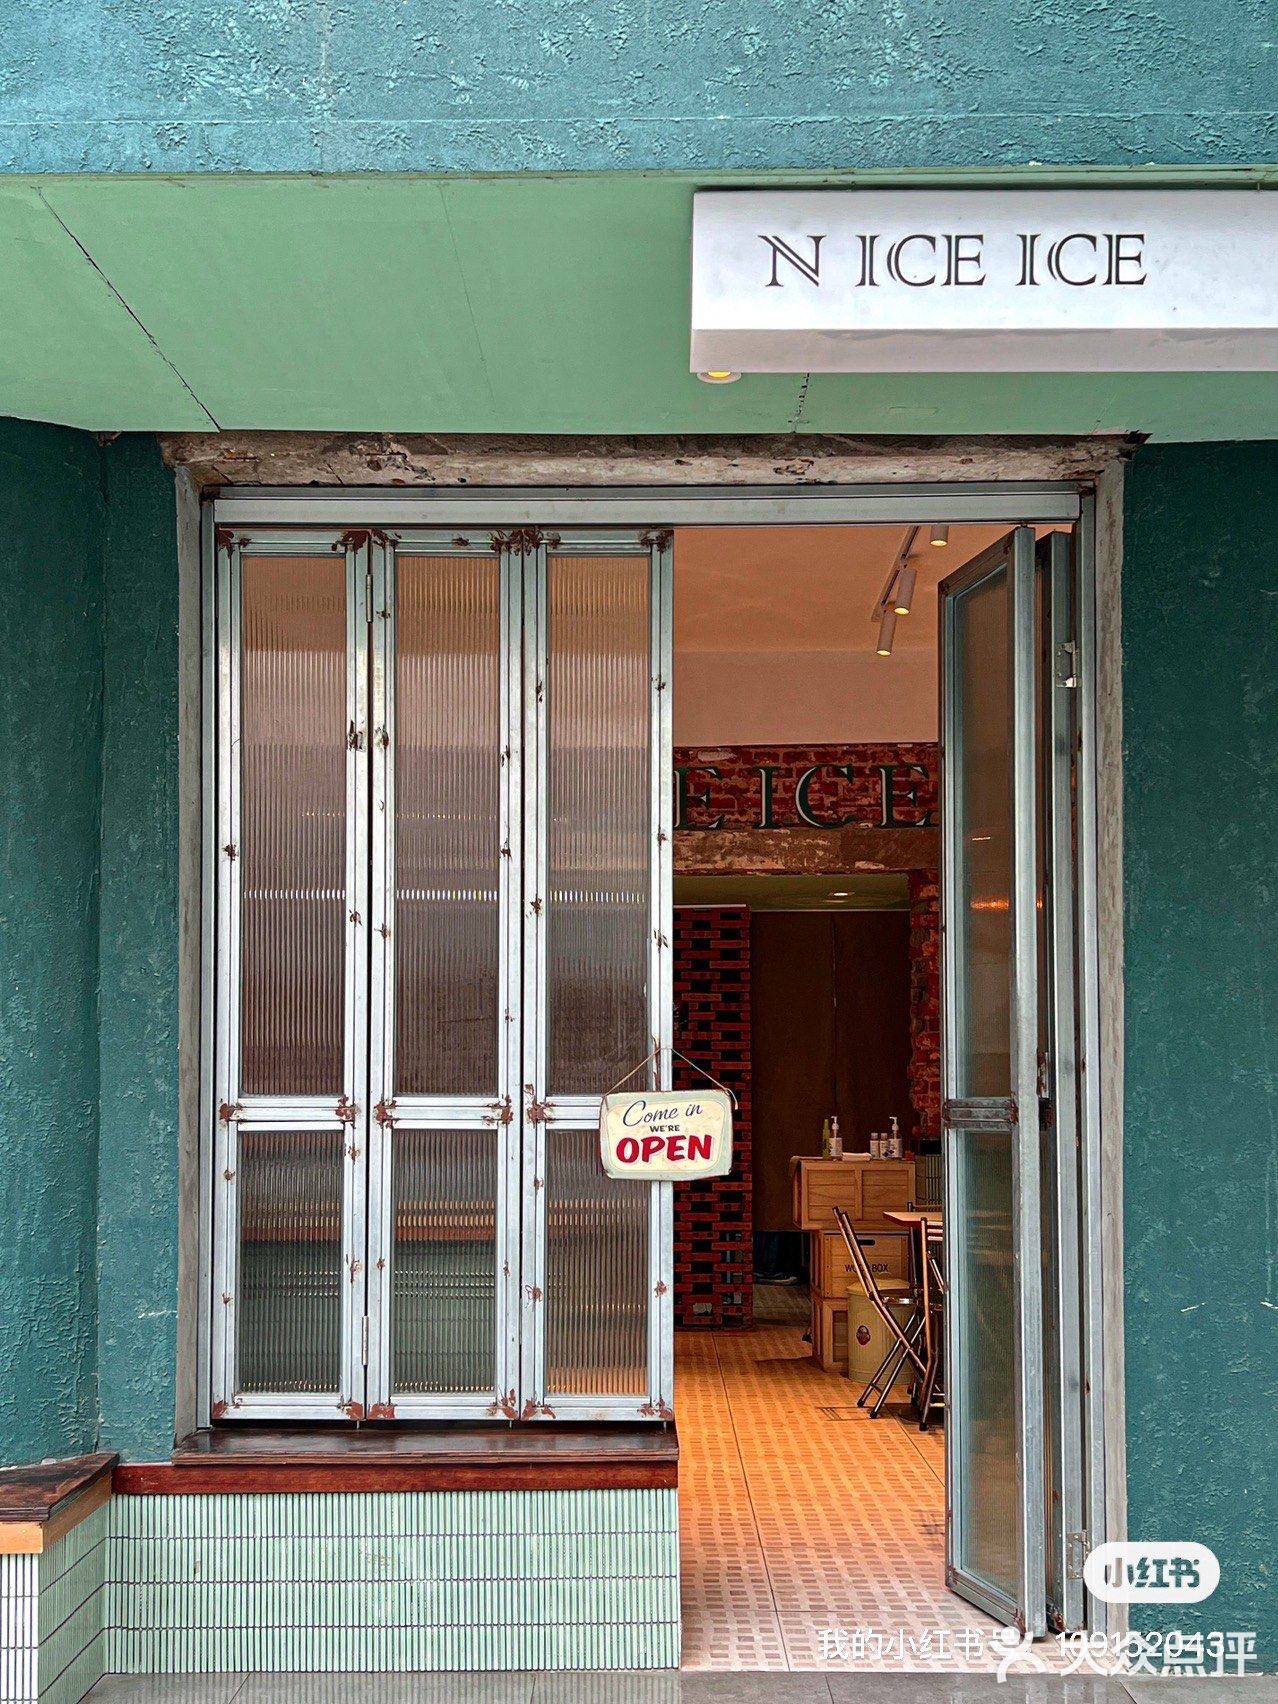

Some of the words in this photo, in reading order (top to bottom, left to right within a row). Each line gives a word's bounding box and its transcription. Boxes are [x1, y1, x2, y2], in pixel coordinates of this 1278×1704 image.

[1015, 233, 1148, 288] ICE
[754, 763, 936, 830] ICE
[622, 1100, 679, 1127] Come
[685, 1103, 704, 1117] in
[649, 1124, 681, 1133] WE'RE
[616, 1134, 712, 1164] OPEN
[871, 1263, 889, 1273] BOX
